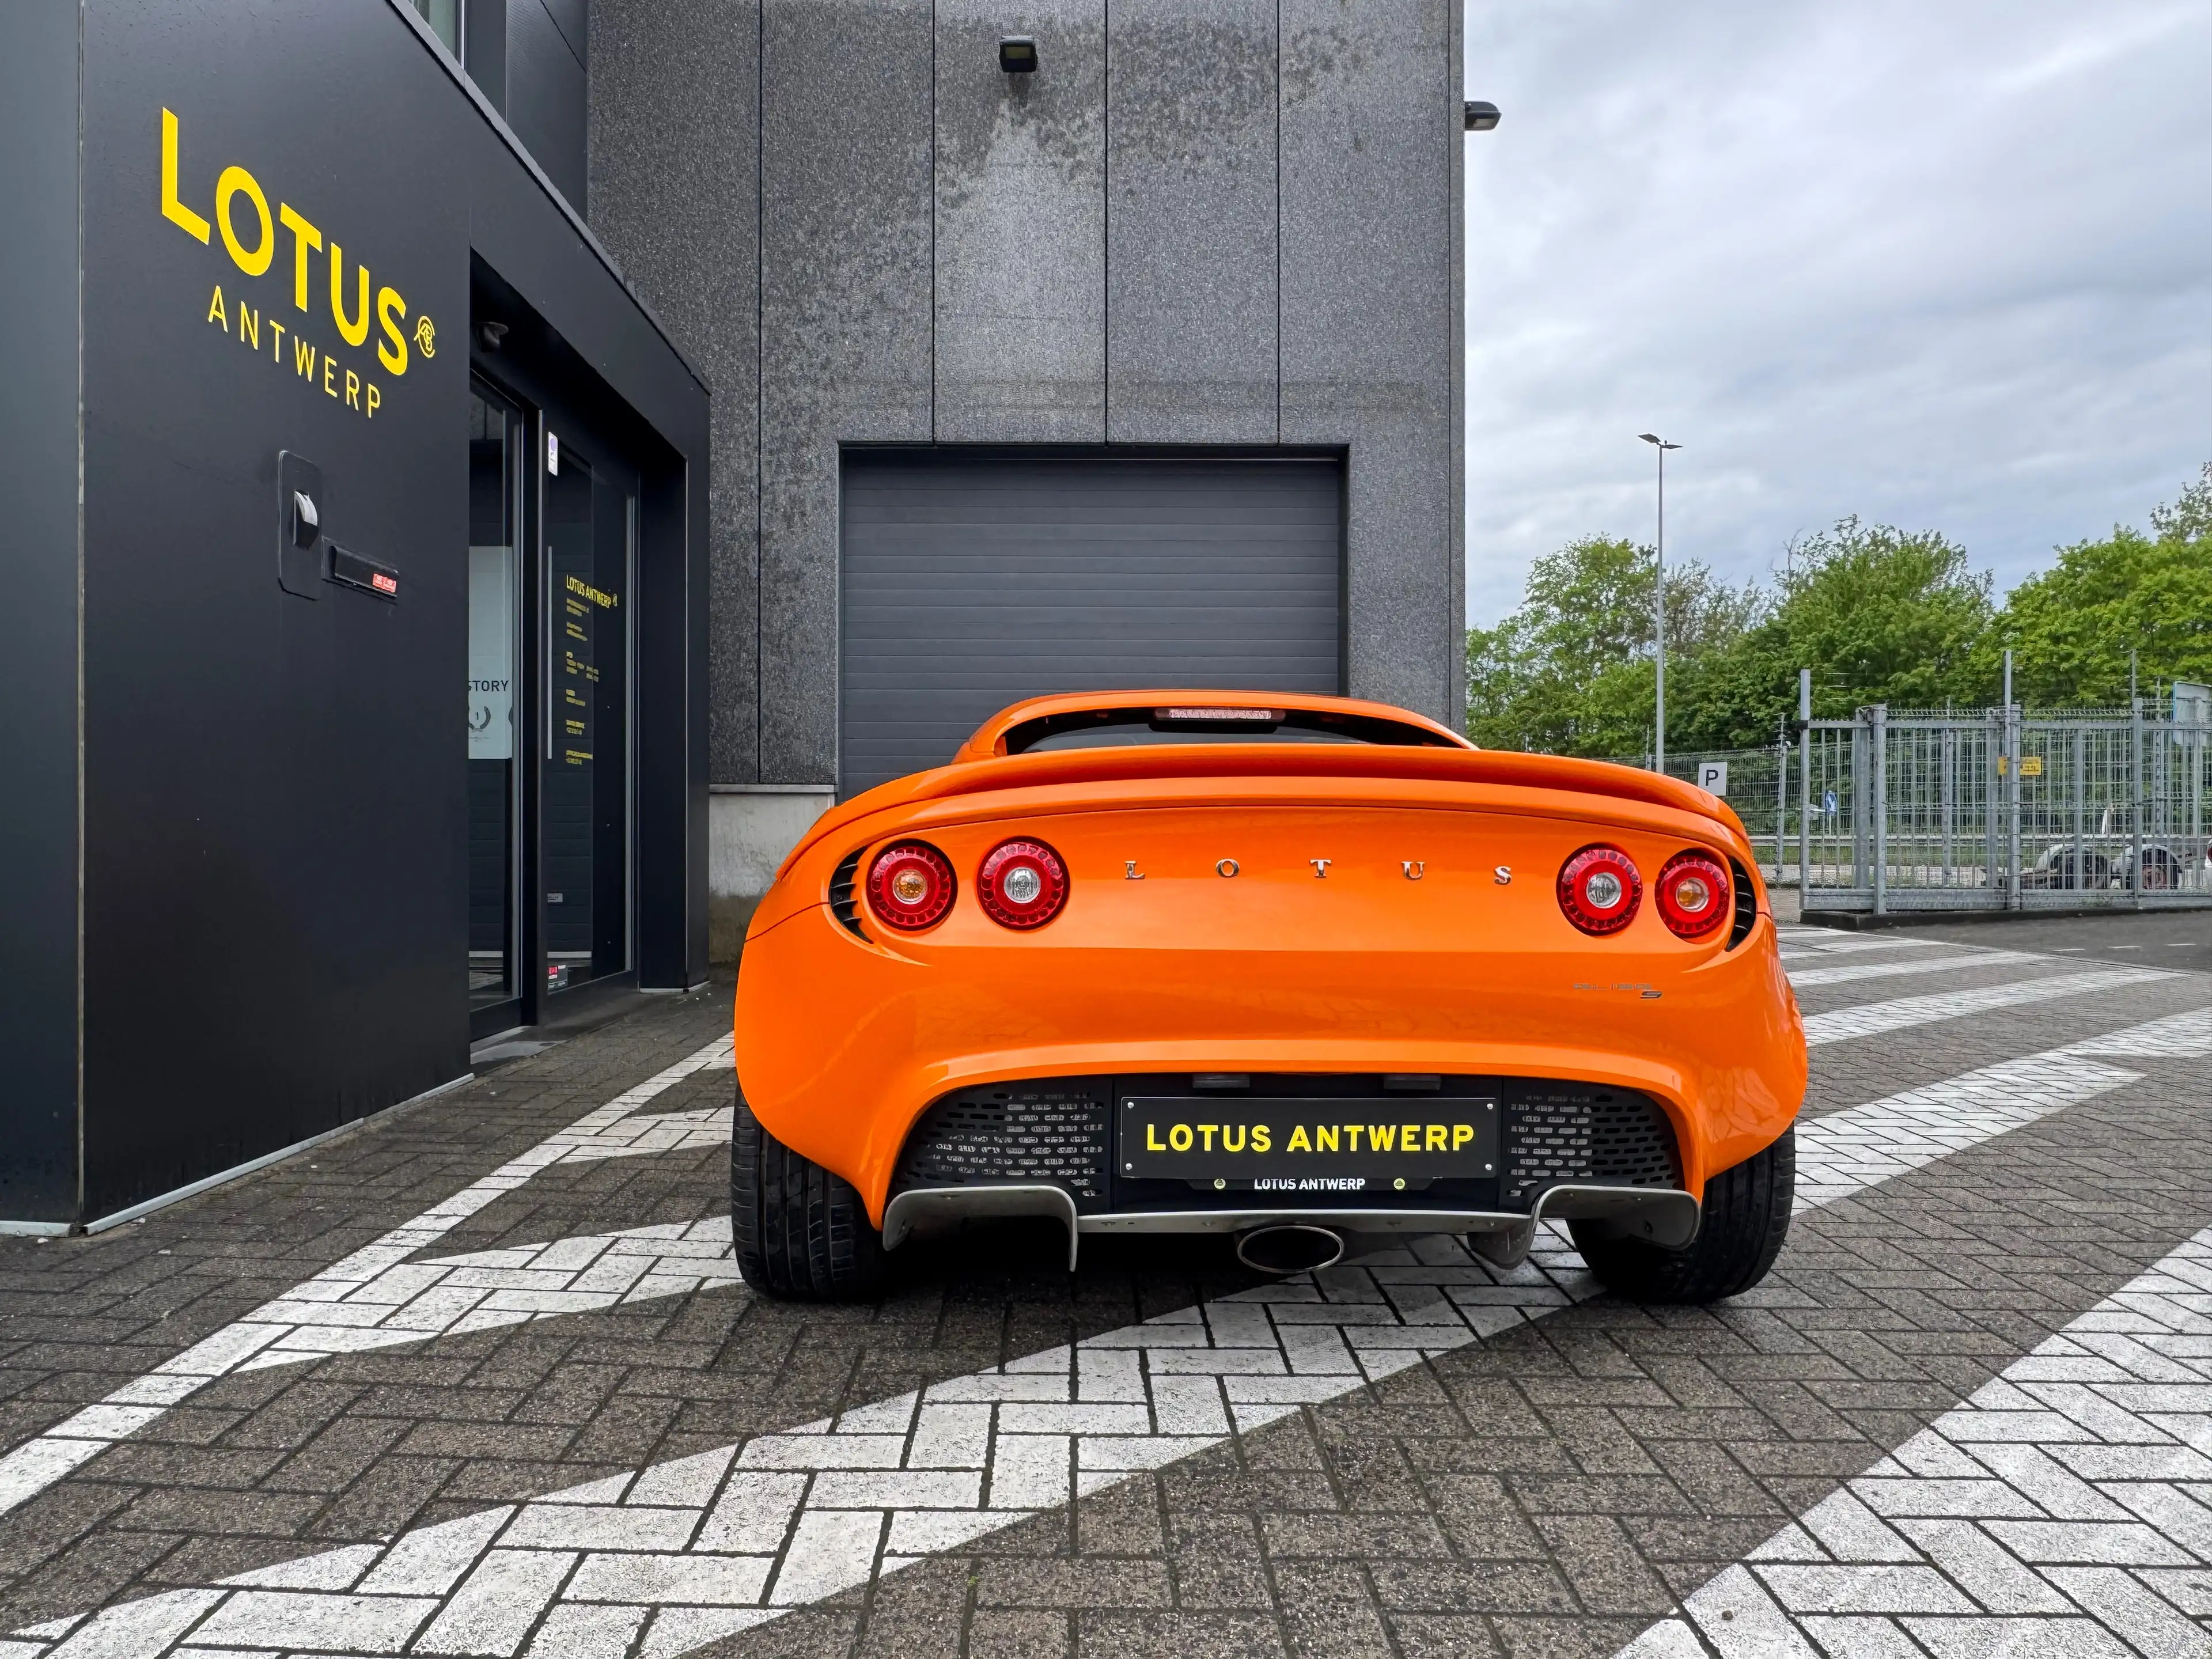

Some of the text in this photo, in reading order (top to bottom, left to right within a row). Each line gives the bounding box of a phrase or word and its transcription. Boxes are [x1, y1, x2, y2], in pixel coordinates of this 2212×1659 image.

[161, 107, 408, 376] LOTUS
[208, 285, 381, 418] ANTWERP
[566, 574, 585, 596] LOTUS
[585, 585, 611, 609] ANTWERP
[1705, 769, 1719, 786] P
[1124, 858, 1512, 885] LOTUS
[1146, 1123, 1475, 1152] LOTUS ANTWERP
[1254, 1178, 1366, 1190] LOTUS ANTWERP
